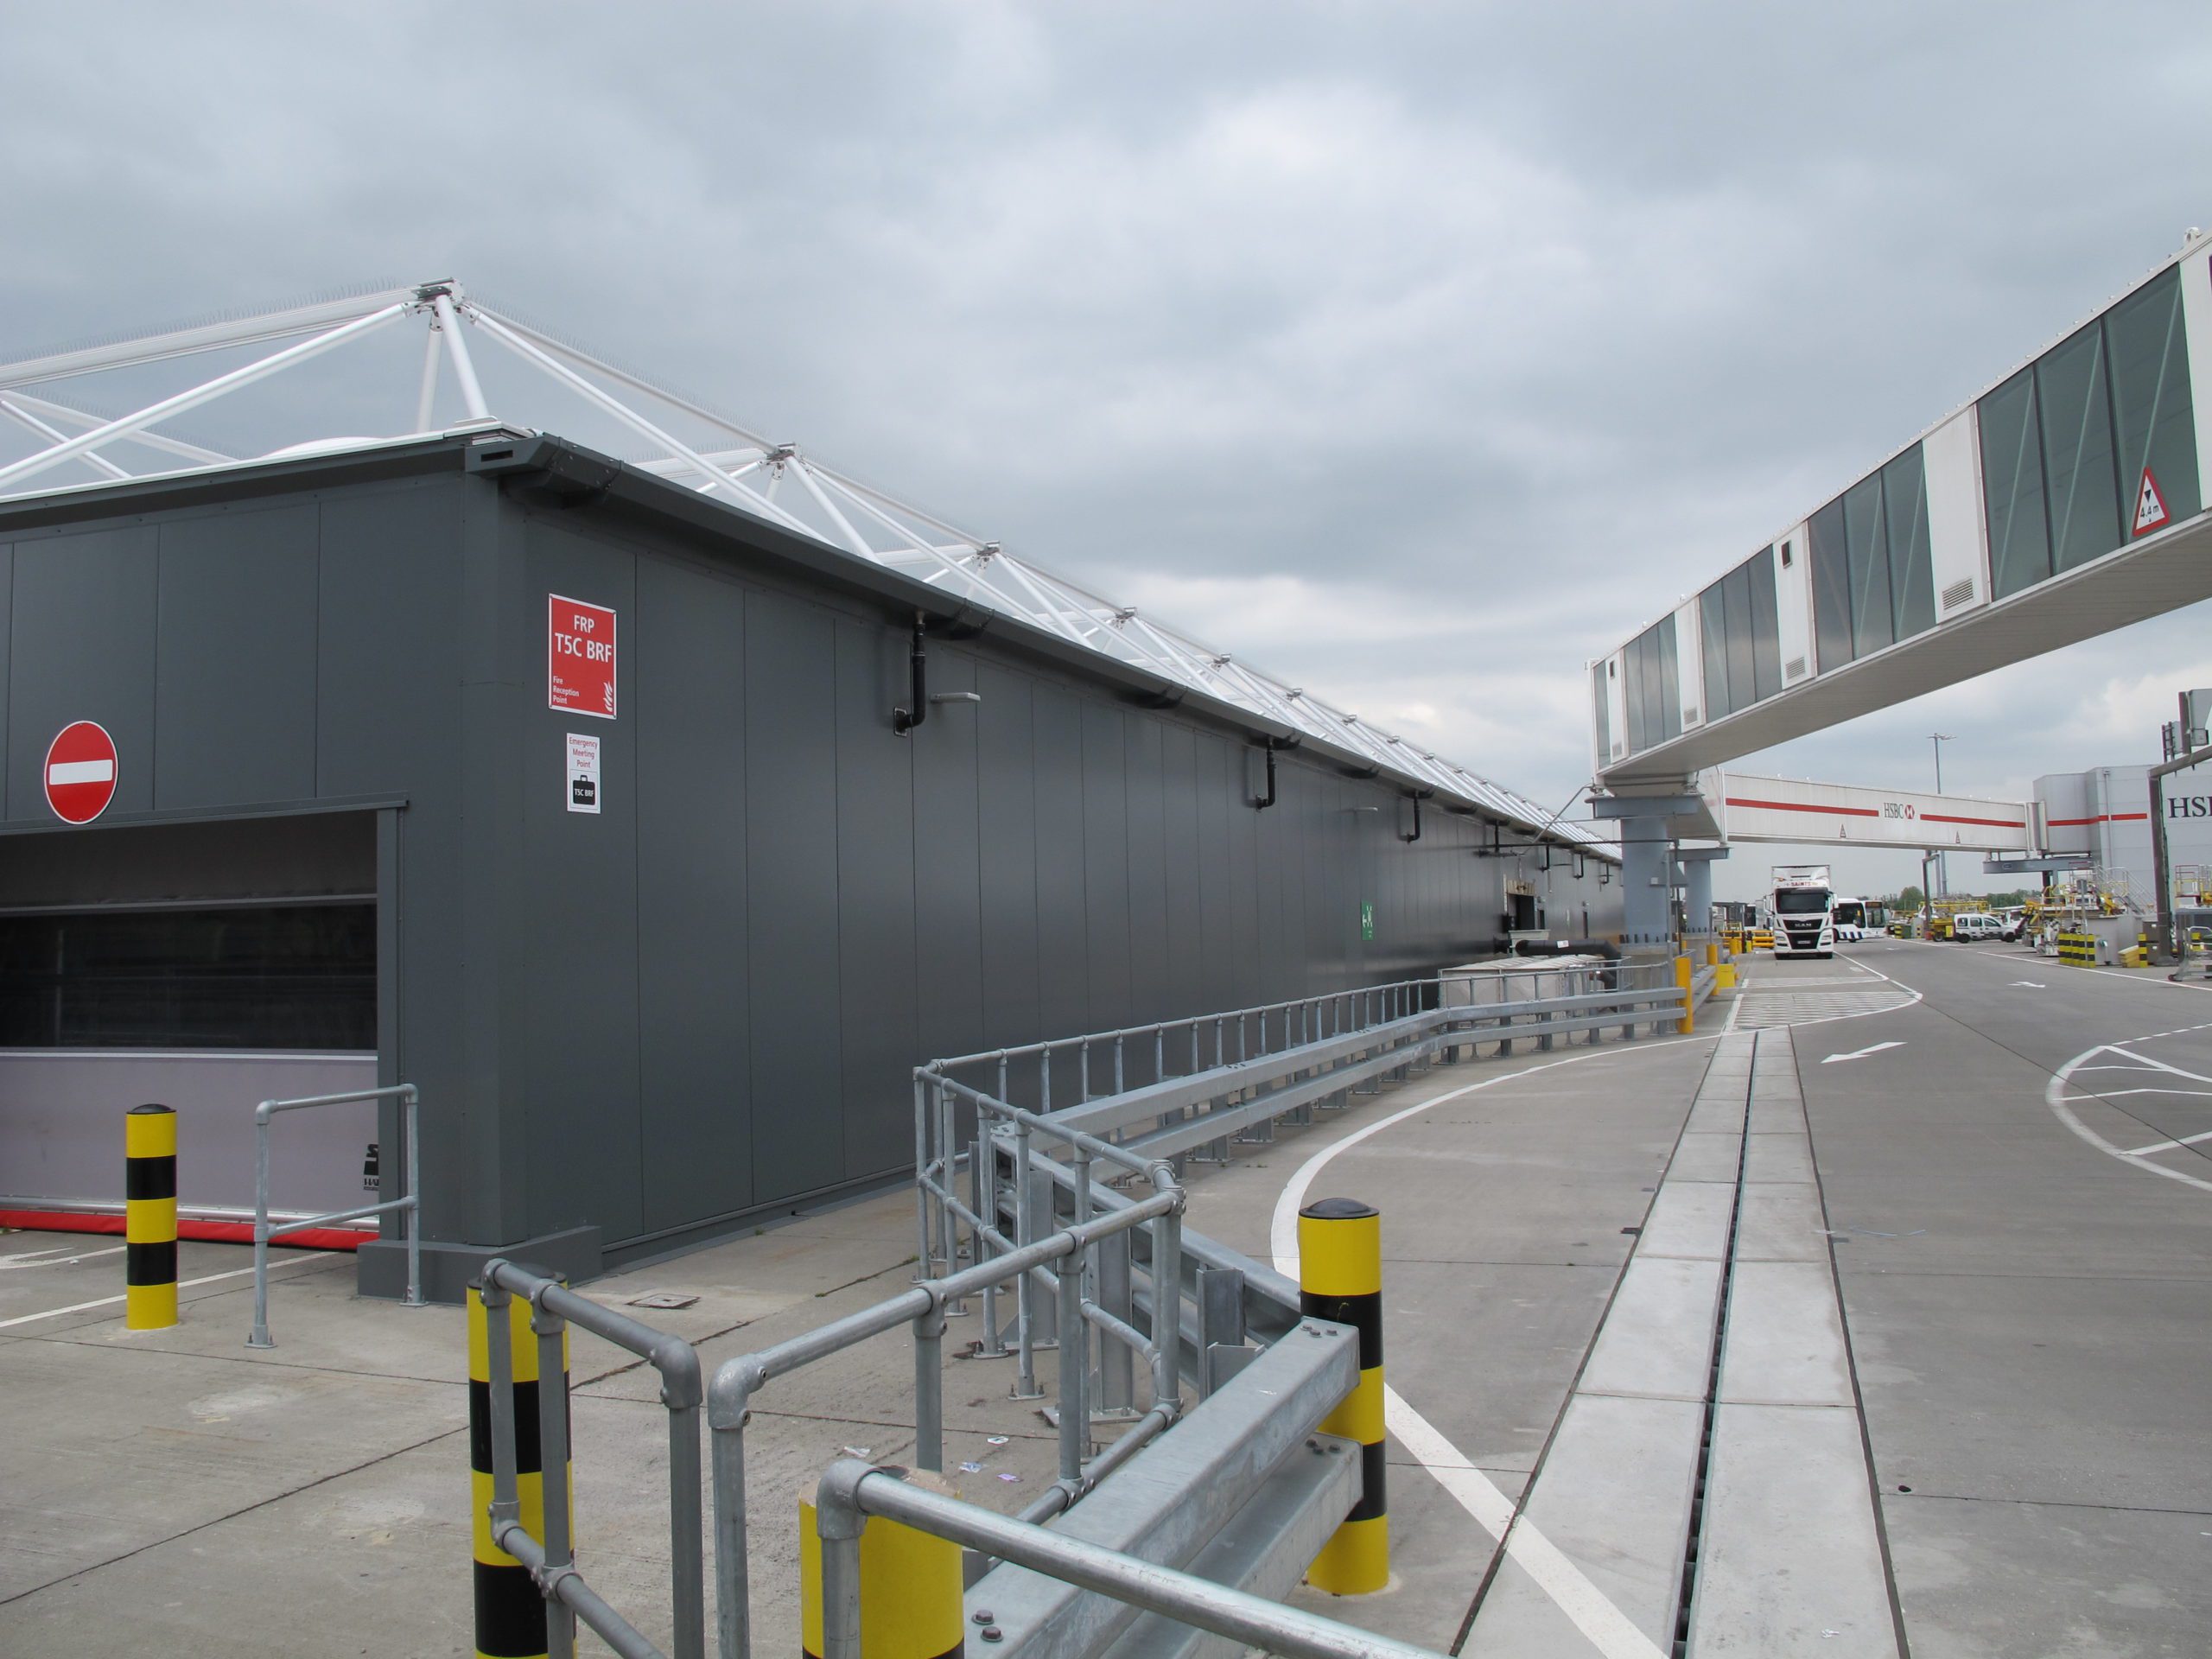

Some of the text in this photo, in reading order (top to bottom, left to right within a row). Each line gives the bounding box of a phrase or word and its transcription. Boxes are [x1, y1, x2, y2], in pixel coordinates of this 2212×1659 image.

[574, 614, 595, 633] FRP
[555, 632, 613, 663] T5C BRF
[553, 676, 563, 684] Fire
[553, 685, 580, 697] Reception
[553, 695, 568, 704] Point
[569, 736, 598, 749] Emergency
[573, 748, 595, 760] Meeting
[576, 760, 591, 768] Point
[575, 788, 594, 798] T5C BRF
[1884, 802, 1904, 819] HSBC
